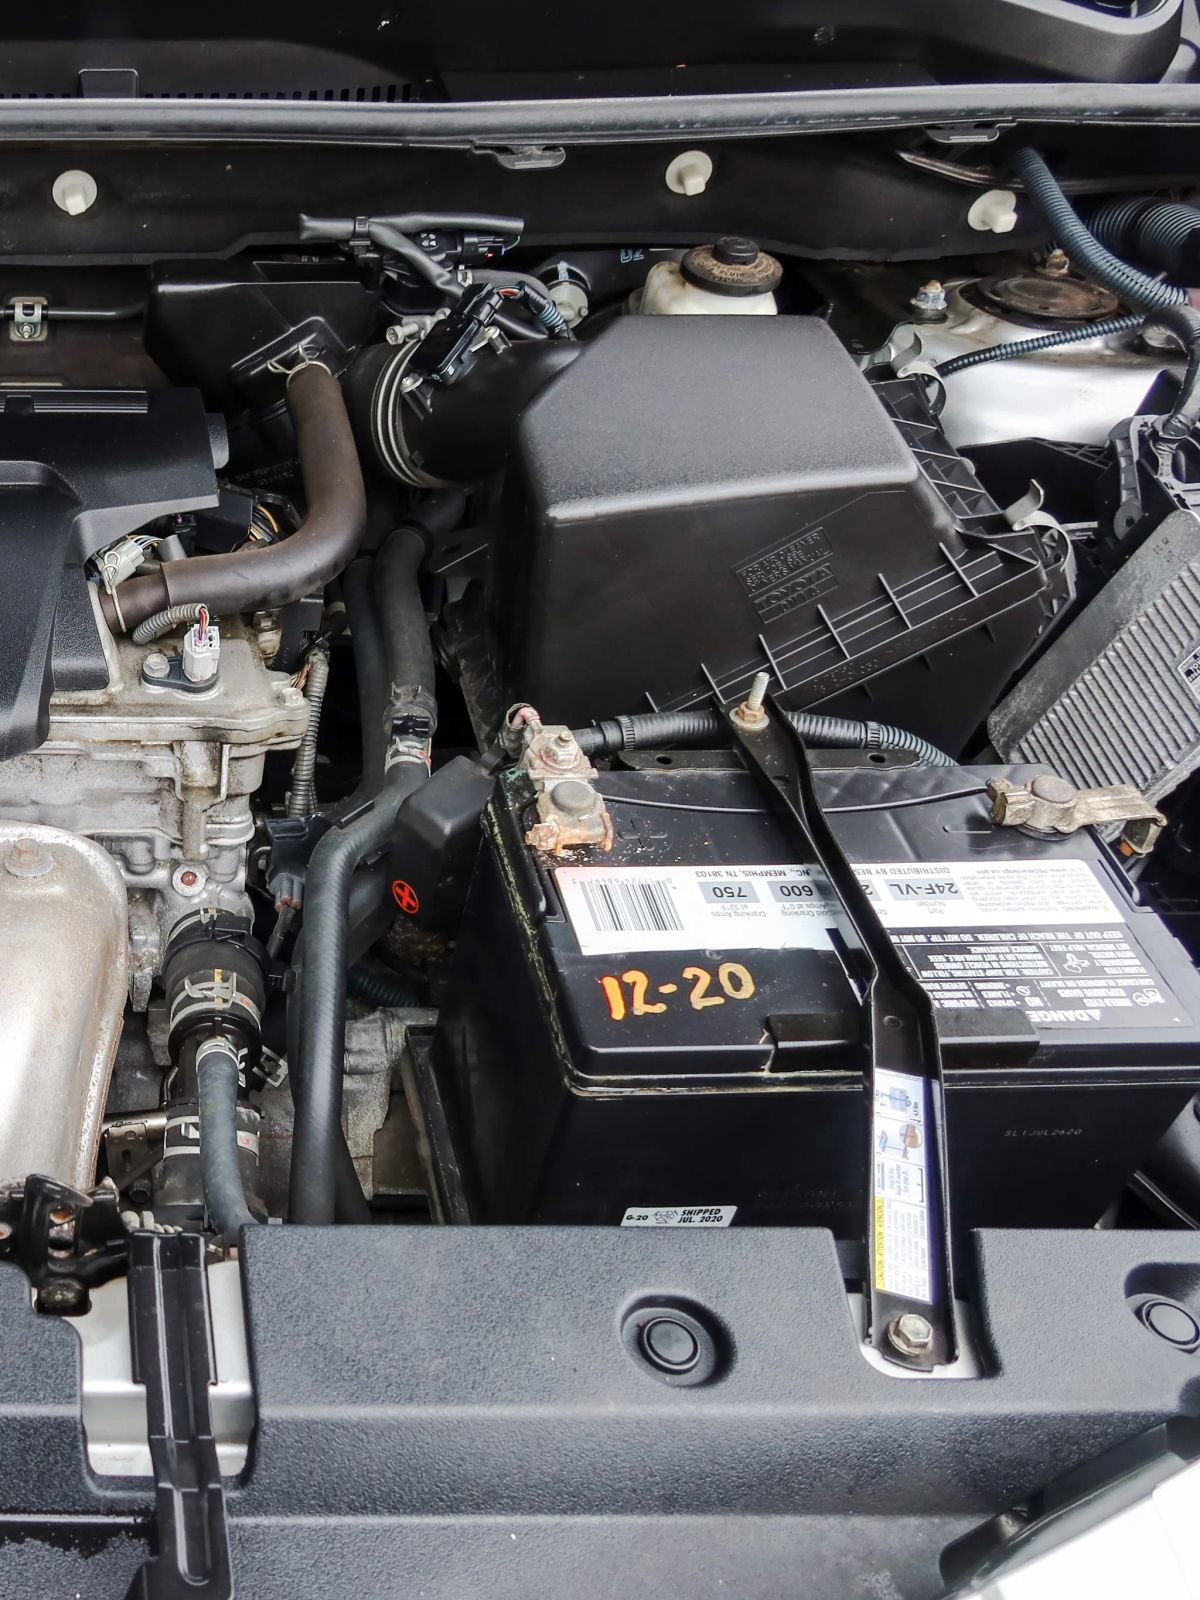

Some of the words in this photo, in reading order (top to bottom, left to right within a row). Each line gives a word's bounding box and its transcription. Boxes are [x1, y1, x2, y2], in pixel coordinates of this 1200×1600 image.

[755, 566, 832, 609] TOYOTA
[695, 870, 723, 878] 38103
[790, 869, 810, 877] NC.,
[890, 867, 951, 875] DISTRIBUTED
[712, 886, 747, 898] 750
[779, 885, 813, 897] 600
[860, 885, 873, 895] 2
[889, 883, 959, 895] 24F-VL
[732, 909, 766, 917] Cranking
[781, 909, 815, 917] Cranking
[600, 962, 755, 1021] 12-20
[1024, 1010, 1089, 1022] DANGE
[680, 1208, 721, 1216] SHIPPED
[677, 1216, 696, 1224] JUL.
[698, 1215, 724, 1223] 2020
